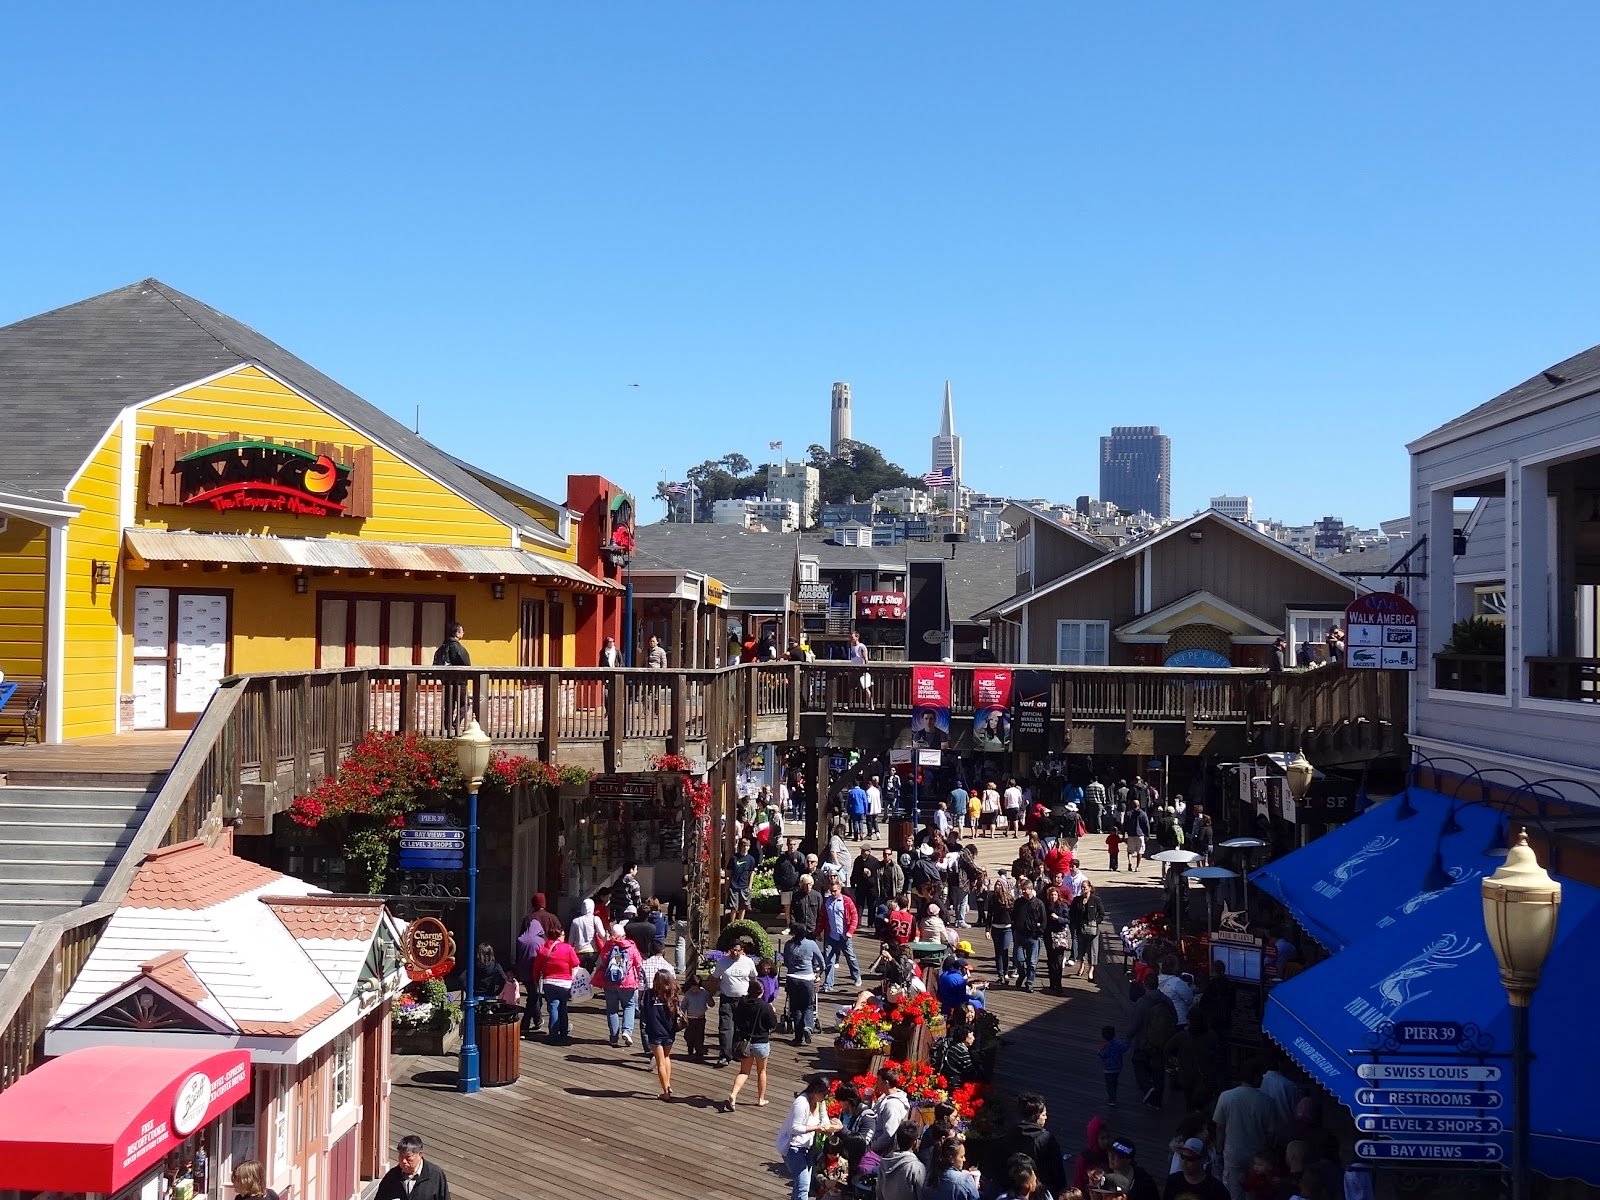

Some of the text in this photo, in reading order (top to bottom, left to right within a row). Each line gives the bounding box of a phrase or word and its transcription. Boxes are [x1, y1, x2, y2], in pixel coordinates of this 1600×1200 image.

[211, 491, 327, 516] The Flavor of Mexico
[800, 584, 829, 592] HARRY
[798, 591, 830, 599] MASON
[869, 595, 903, 606] NFL Shop
[1349, 611, 1416, 624] WALK AMERICA
[1019, 700, 1048, 708] verizon
[599, 784, 645, 793] CITY WEAR
[1304, 797, 1313, 809] I
[1326, 796, 1348, 809] SF
[421, 814, 437, 822] PIER
[890, 919, 910, 937] 23
[413, 930, 443, 941] Charms
[1404, 1026, 1456, 1040] PIER 39
[1384, 1066, 1469, 1079] SWISS LOUIS
[1389, 1092, 1472, 1105] RESTROOMS
[141, 1118, 155, 1135] FREE
[1381, 1119, 1483, 1132] LEVEL 2 SHOPS
[1390, 1144, 1462, 1158] BAY VIEWS
